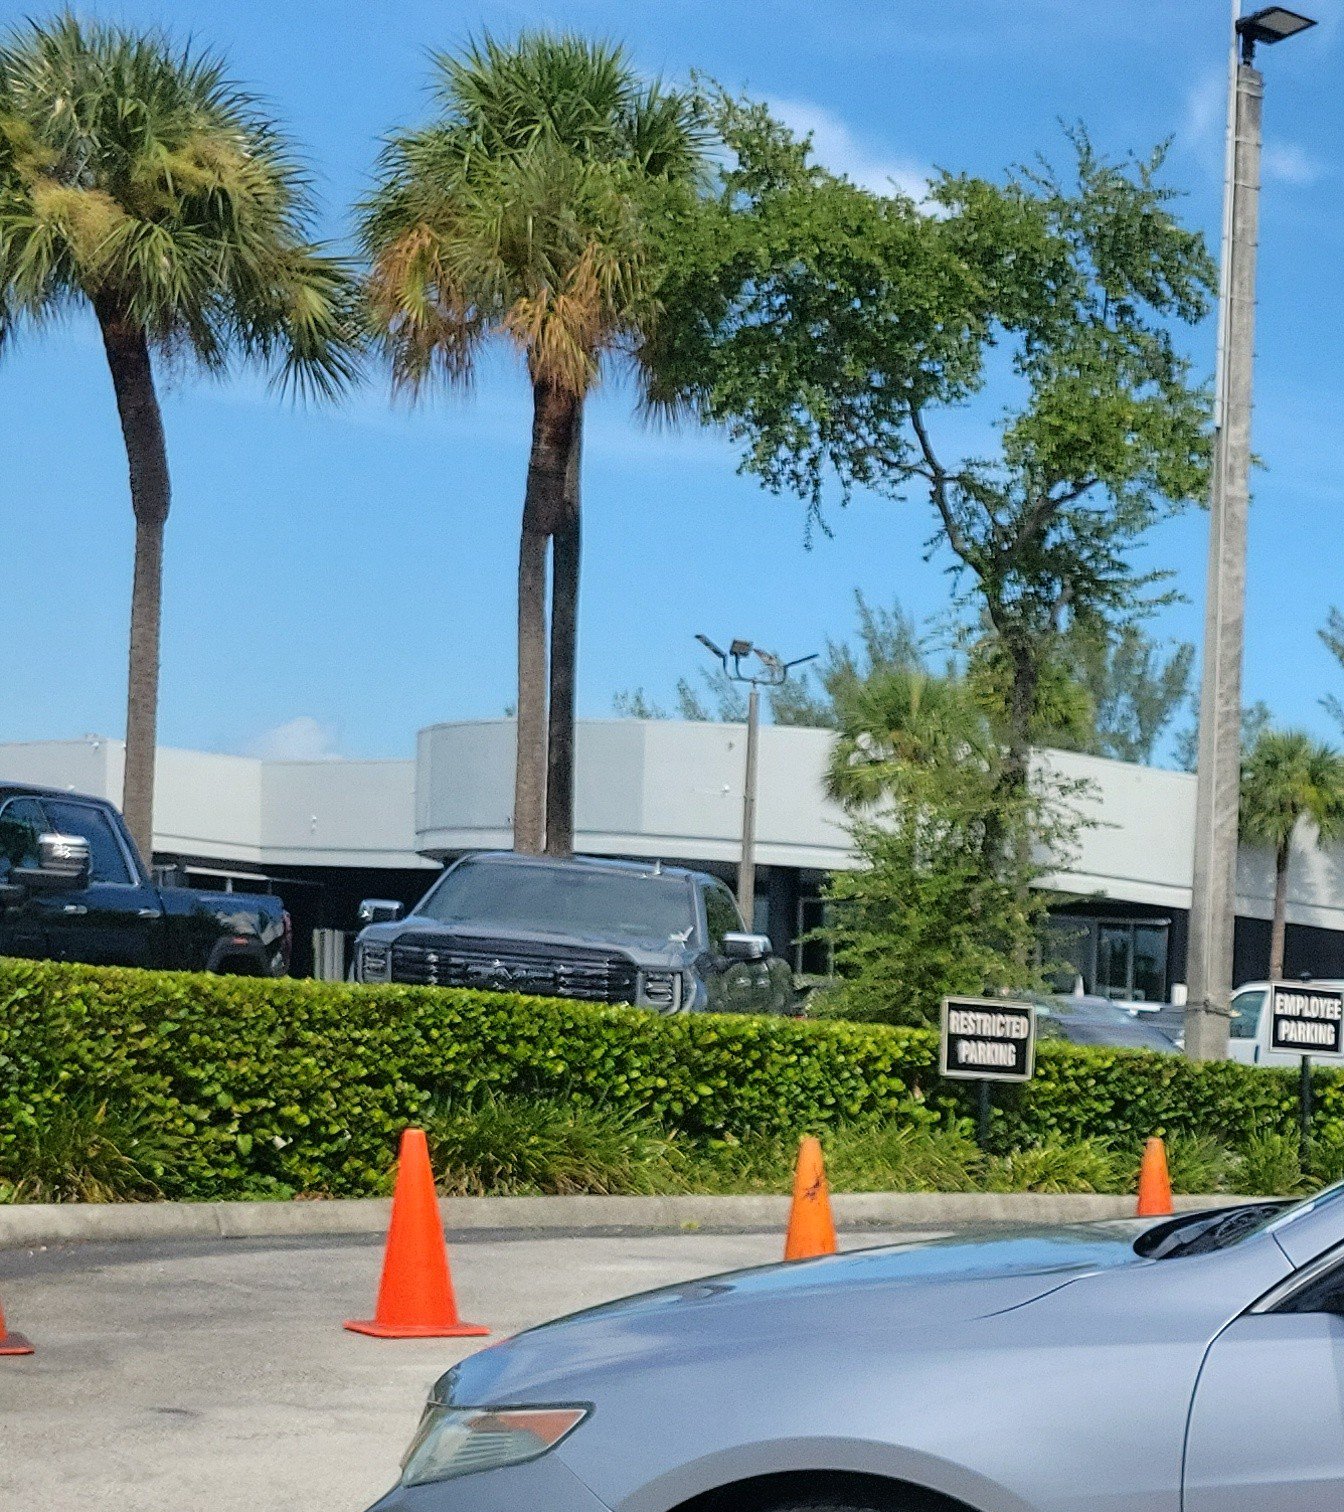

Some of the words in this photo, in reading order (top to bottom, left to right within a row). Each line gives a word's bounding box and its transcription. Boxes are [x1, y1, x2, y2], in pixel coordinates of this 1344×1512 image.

[1275, 992, 1342, 1020] EMPLOYEE
[949, 1009, 1029, 1039] RESTRICTED
[1278, 1019, 1336, 1045] PARKING
[957, 1039, 1016, 1067] PARKING
